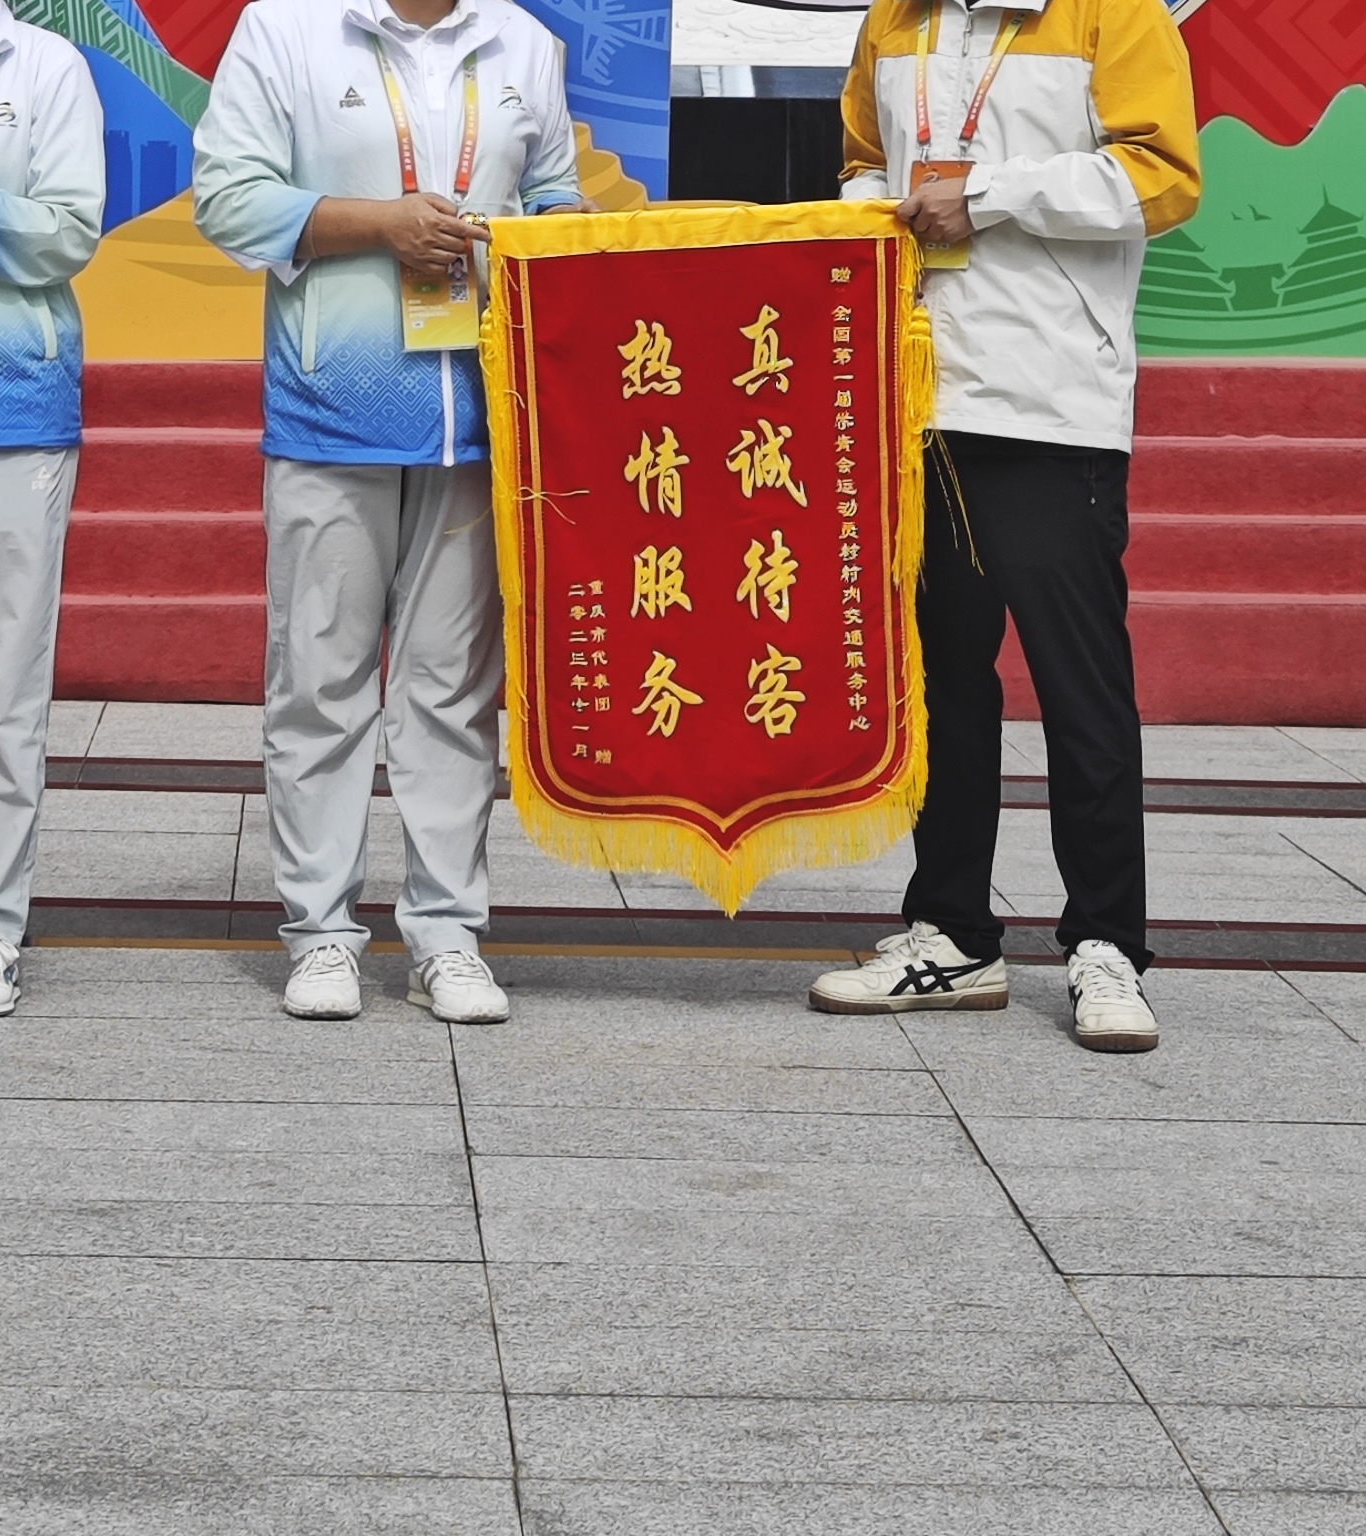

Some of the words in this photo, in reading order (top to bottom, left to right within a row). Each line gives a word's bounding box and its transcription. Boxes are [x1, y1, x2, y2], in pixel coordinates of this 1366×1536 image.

[616, 318, 704, 738] 热情服务
[725, 304, 808, 740] 真诚待客
